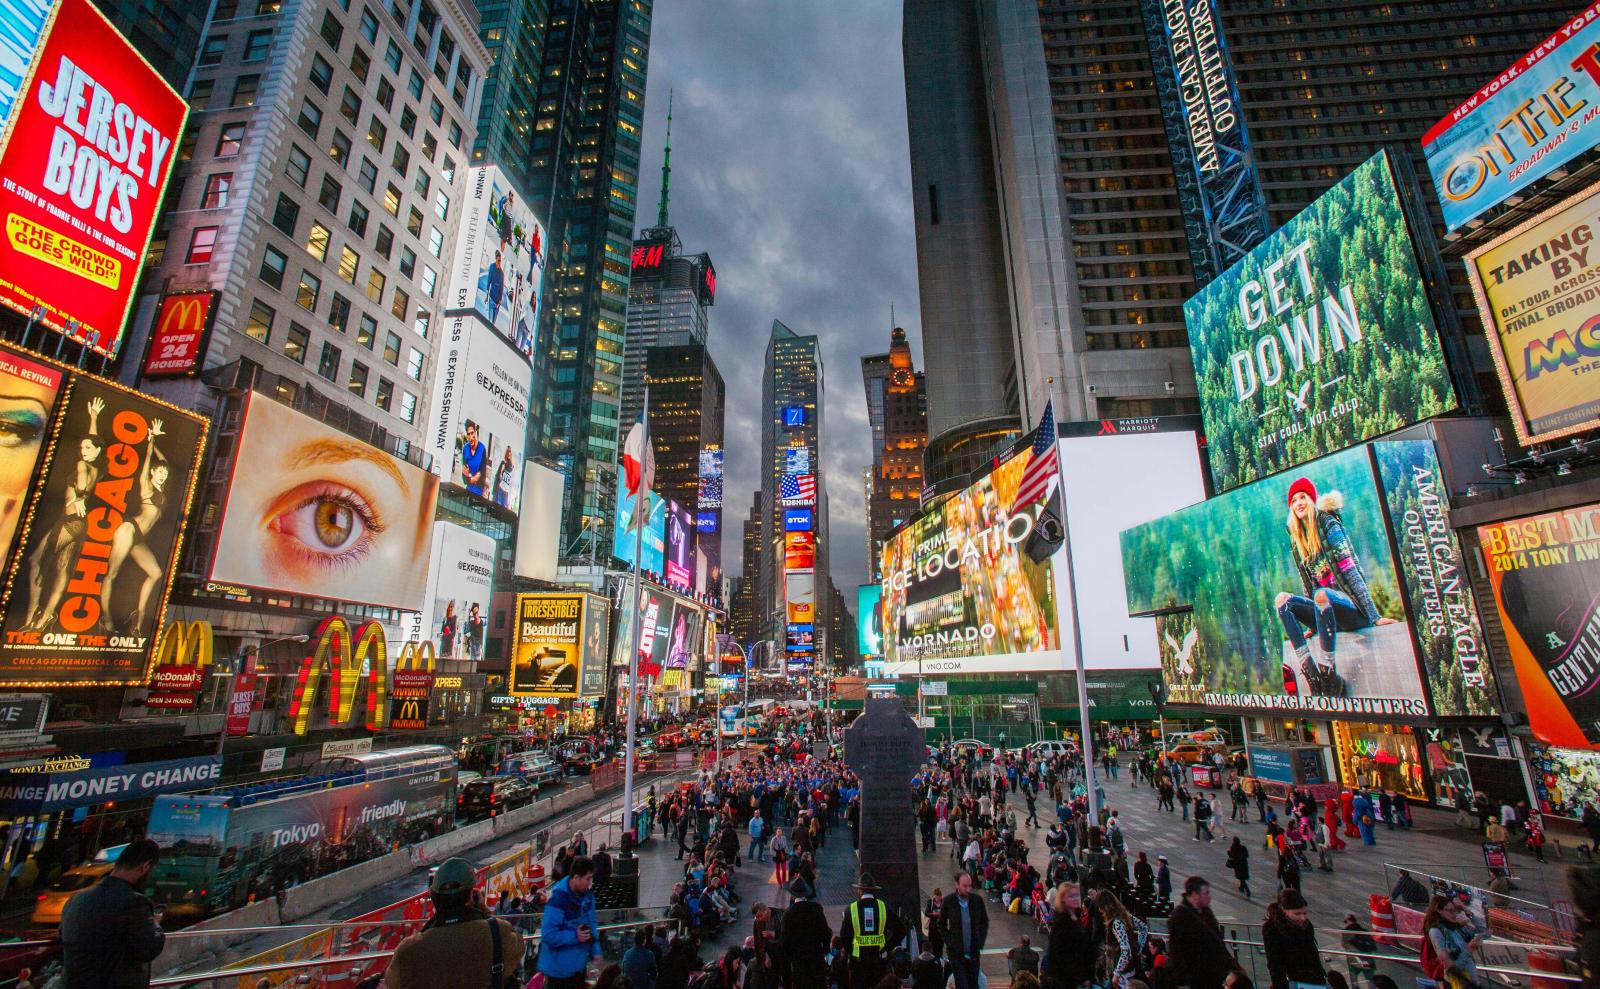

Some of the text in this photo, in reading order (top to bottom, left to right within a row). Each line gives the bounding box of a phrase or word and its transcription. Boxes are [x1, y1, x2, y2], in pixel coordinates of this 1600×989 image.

[1453, 96, 1478, 121] NEW
[1481, 67, 1522, 98] YORK,
[1526, 36, 1557, 65] NEW
[37, 54, 171, 188] JERSEY
[1177, 54, 1219, 172] AMERICAN
[1442, 133, 1516, 202] ON
[1497, 76, 1588, 148] THE
[1508, 119, 1580, 184] BROADWAY'S
[43, 125, 138, 234] BOYS
[3, 177, 16, 192] THE
[16, 186, 38, 204] STORY
[37, 198, 47, 209] OF
[46, 202, 71, 224] FRANKIE
[71, 217, 87, 232] VALLI
[86, 226, 92, 236] &
[92, 229, 103, 241] THE
[15, 232, 63, 259] GOES
[59, 239, 115, 270] CROWD
[1489, 224, 1594, 285] TAKING
[1551, 246, 1590, 280] BY
[1238, 239, 1315, 331] GET
[1501, 304, 1517, 319] ON
[1519, 290, 1551, 313] TOUR
[161, 334, 195, 343] OPEN
[1505, 313, 1545, 335] FINAL
[160, 344, 189, 358] 24
[1230, 284, 1363, 402] DOWN
[20, 368, 53, 387] REVIVAL
[149, 359, 193, 369] HOURS
[437, 349, 459, 450] @EXPRESSRUNWAY
[1258, 398, 1363, 448] STAY COOL. NOT COLD.
[59, 410, 149, 633] CHICAGO
[1485, 517, 1561, 555] BEST
[917, 508, 1040, 583] LOCATIO
[918, 527, 953, 557] PRIME
[1493, 551, 1529, 572] 2014
[1529, 545, 1571, 568] TONY
[1405, 510, 1448, 637] OUTFITTERS
[1413, 464, 1487, 688] AMERICAN EAGLE
[6, 631, 146, 648] THE ONE THE ONLY
[522, 622, 577, 636] Beautiful
[902, 622, 997, 650] VORNADO
[1546, 631, 1567, 650] A
[153, 671, 202, 682] McDonald's
[926, 662, 961, 671] VNO.COM
[232, 691, 254, 703] JERSEY
[234, 702, 250, 714] BOYS
[1205, 693, 1429, 717] AMERICAN EAGLE OUTFITTERS
[10, 760, 91, 773] MONEY EXCHANGE
[409, 776, 433, 786] UNITED
[45, 773, 136, 801] MONEY
[141, 763, 222, 789] CHANGE
[362, 800, 407, 824] friendly
[272, 822, 320, 848] Tokyo
